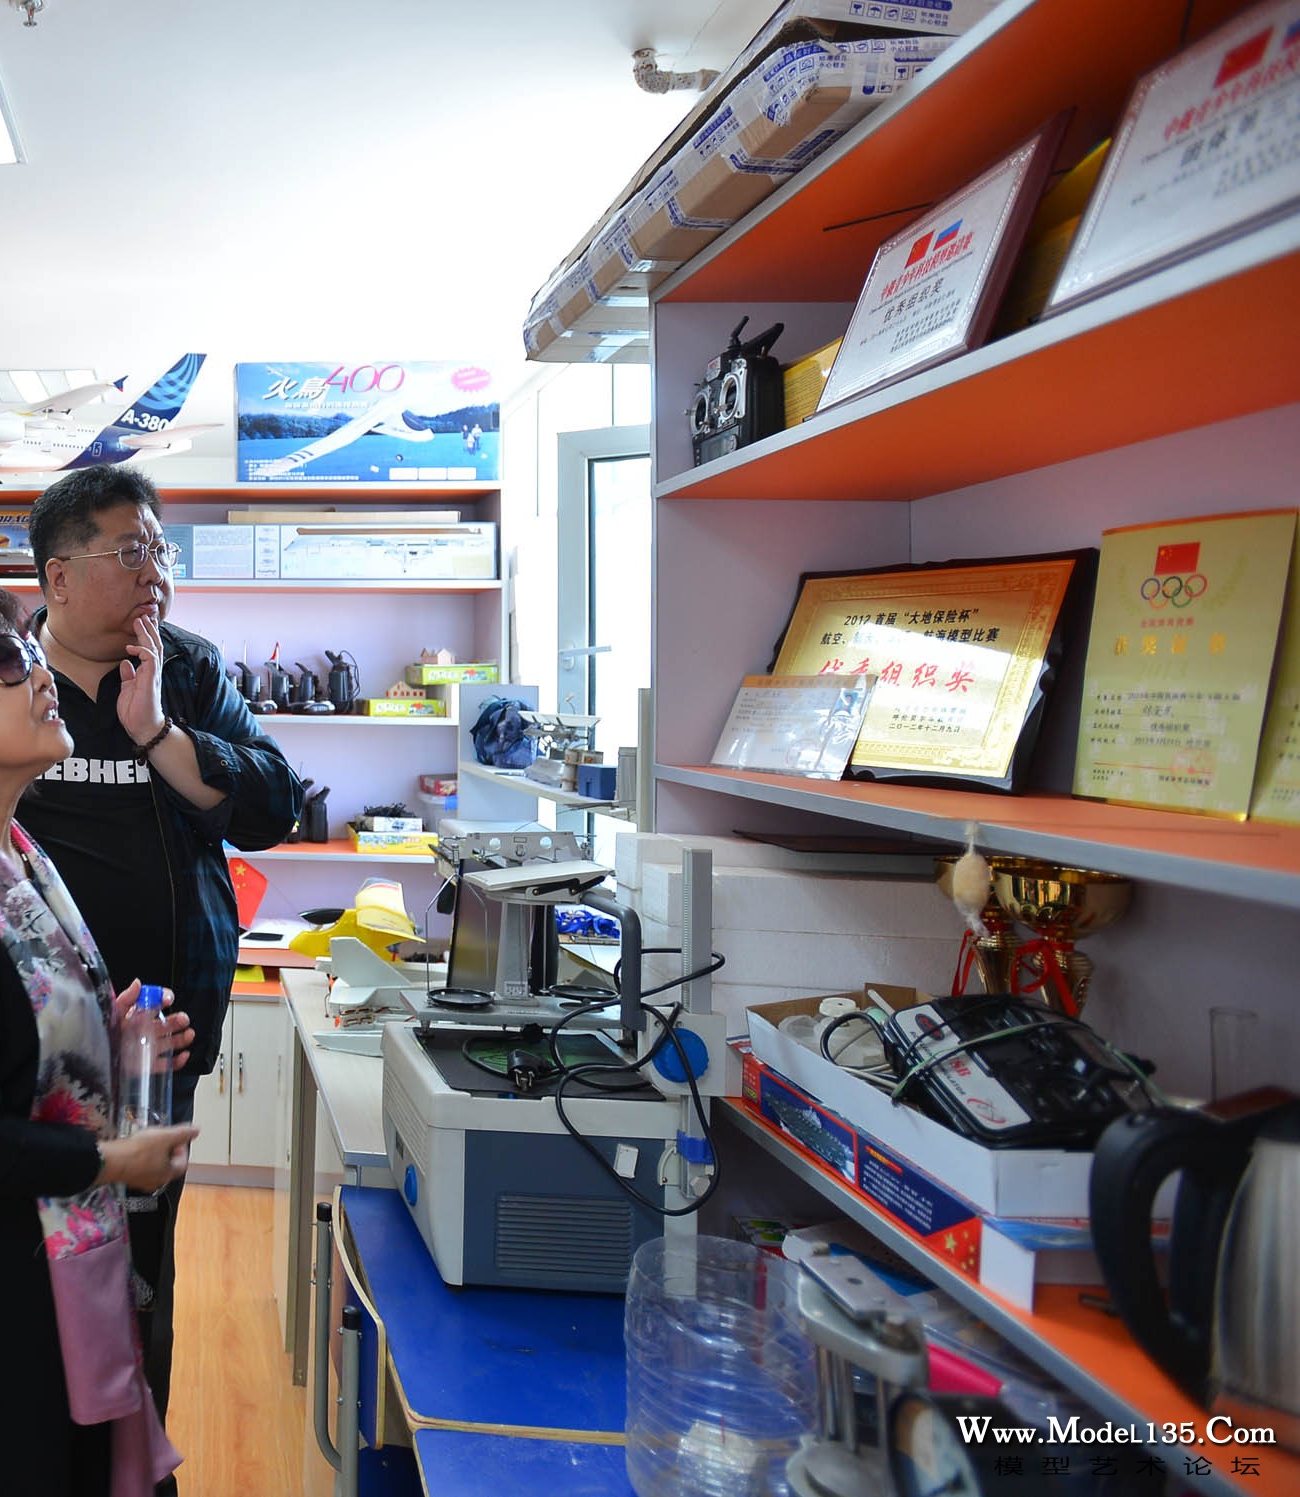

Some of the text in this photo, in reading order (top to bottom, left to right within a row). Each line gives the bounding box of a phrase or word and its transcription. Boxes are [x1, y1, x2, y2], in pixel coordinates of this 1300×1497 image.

[325, 364, 405, 393] 400
[121, 409, 170, 432] A-380
[844, 615, 871, 626] 2012
[875, 612, 898, 626] 首届
[35, 757, 150, 784] EBHE
